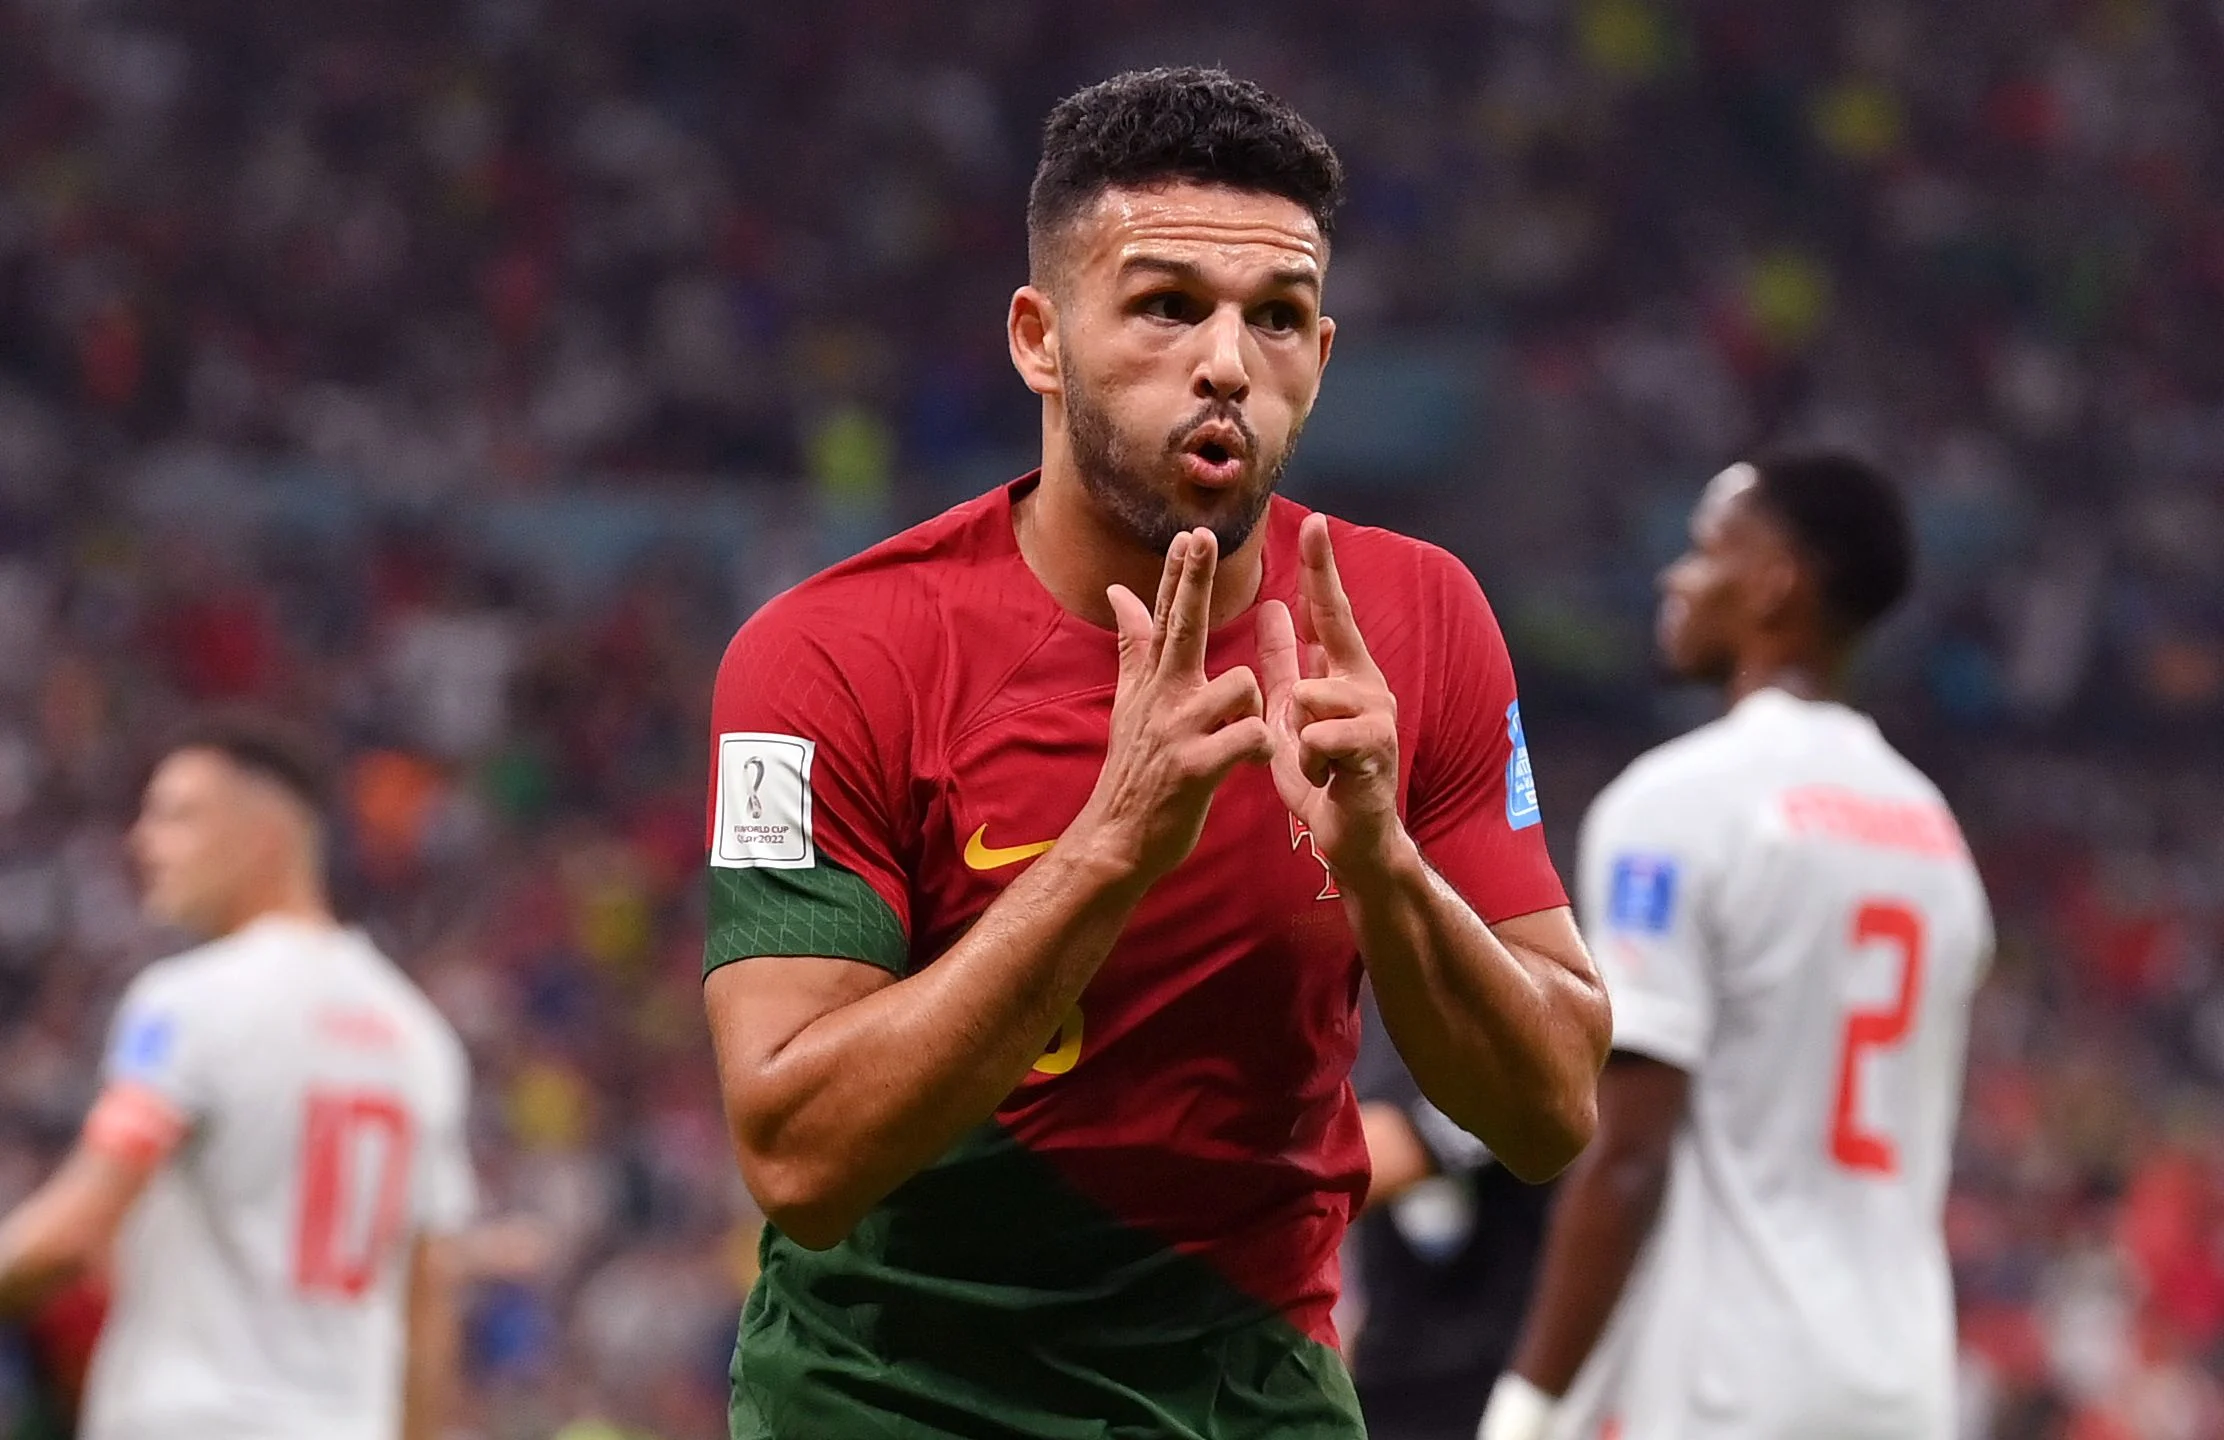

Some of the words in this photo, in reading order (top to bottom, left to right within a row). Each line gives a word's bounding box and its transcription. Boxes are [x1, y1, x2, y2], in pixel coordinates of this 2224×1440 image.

[771, 825, 790, 834] CUP
[1833, 901, 1923, 1174] 2
[297, 1090, 413, 1297] 10
